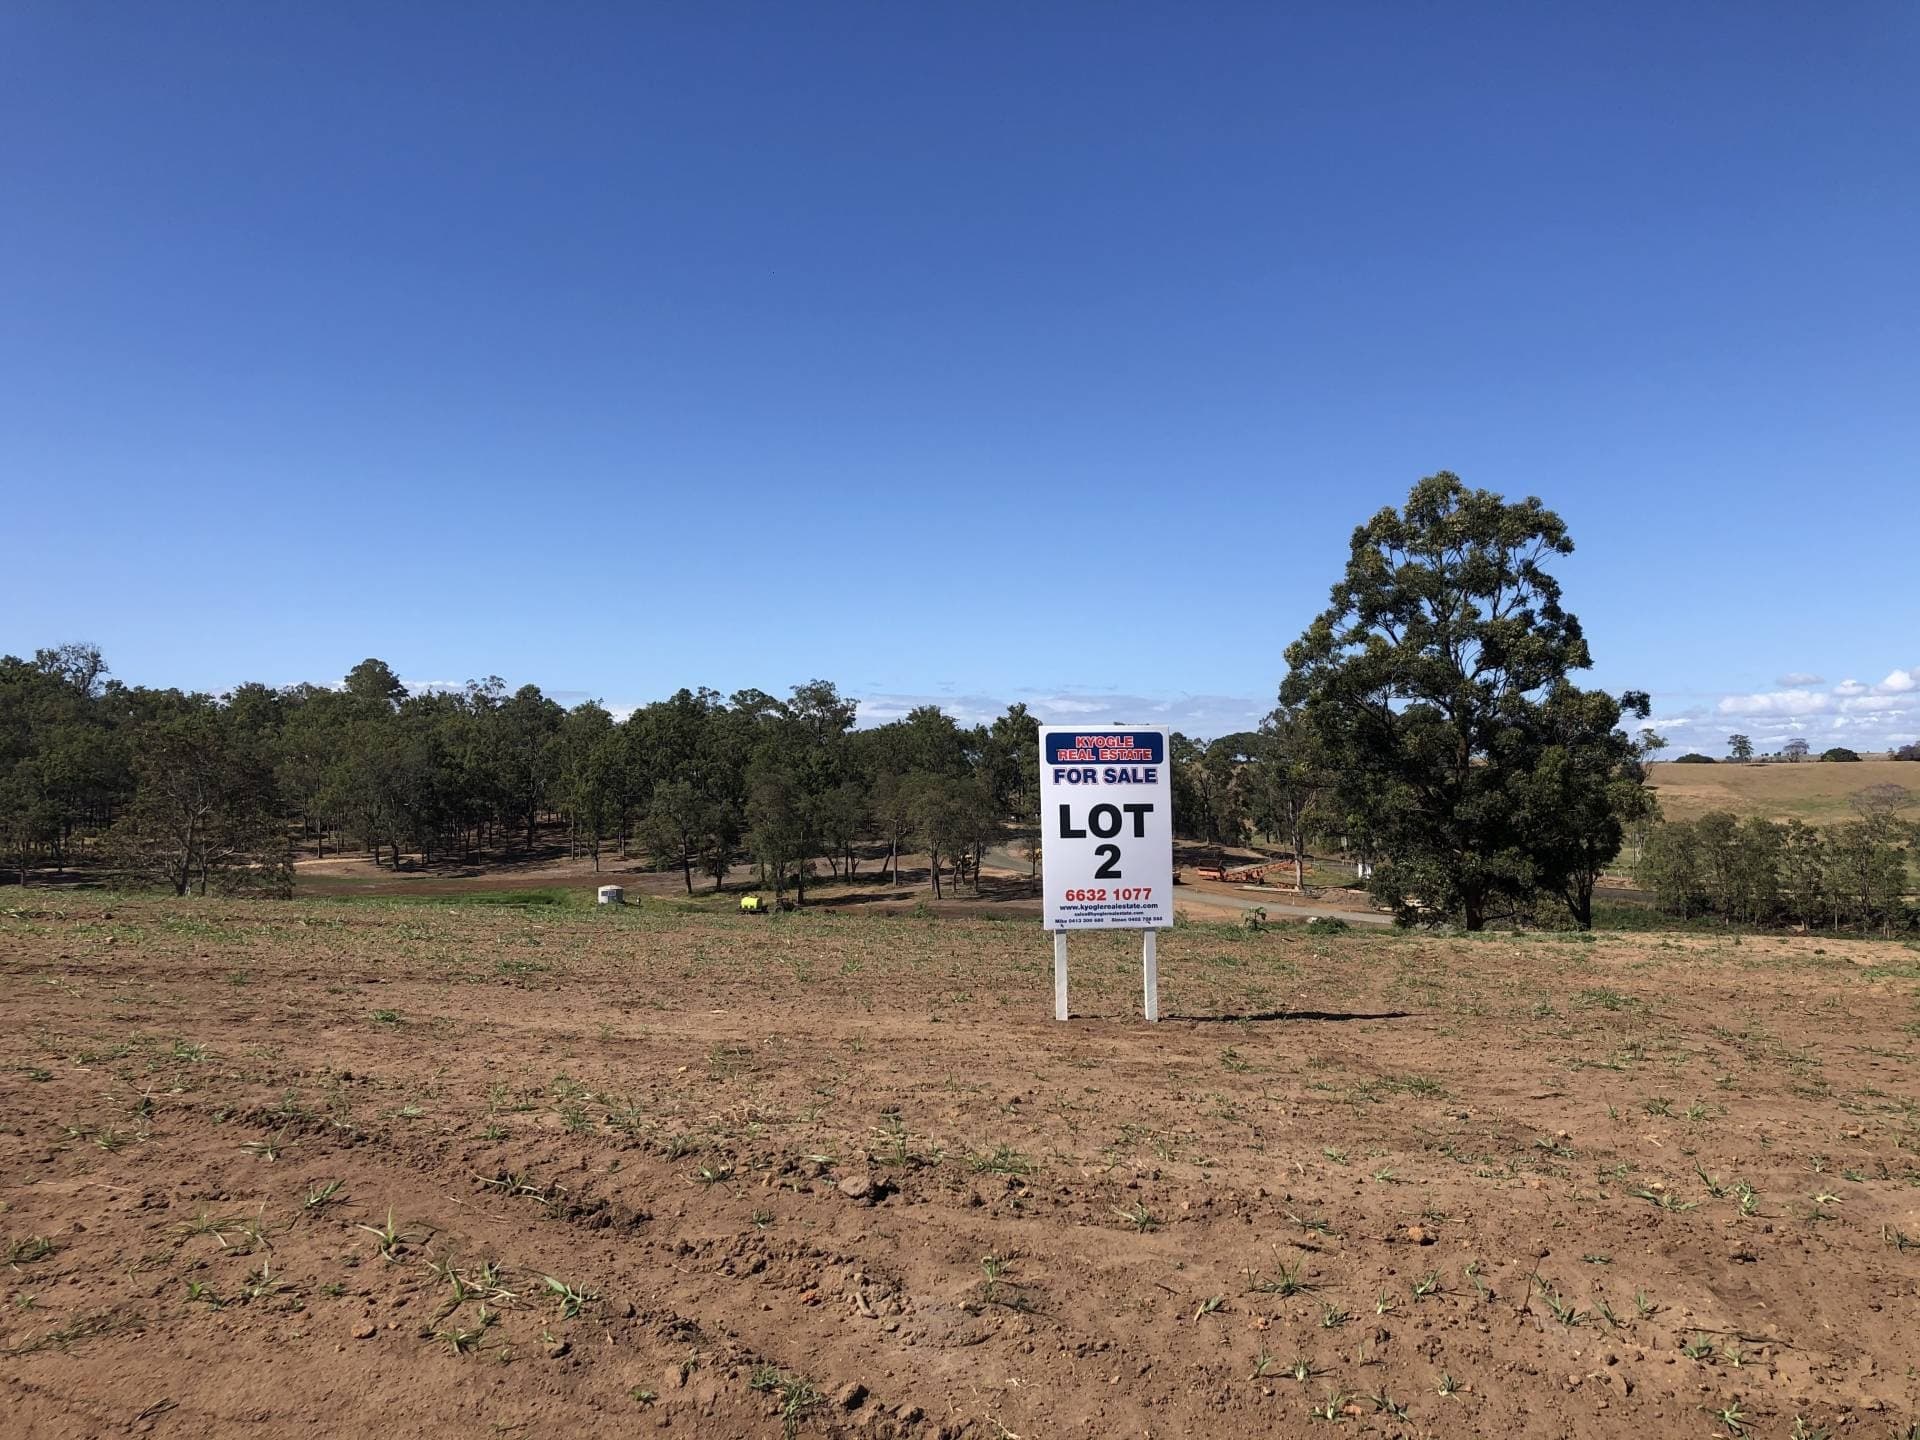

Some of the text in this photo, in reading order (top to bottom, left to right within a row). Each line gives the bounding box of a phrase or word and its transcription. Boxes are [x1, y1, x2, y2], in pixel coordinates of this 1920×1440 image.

[1075, 735, 1134, 748] KYOGLE
[1057, 749, 1152, 761] REAL ESTATE
[1053, 767, 1158, 784] FOR SALE
[1059, 803, 1154, 838] LOT
[1094, 843, 1122, 879] 2
[1065, 888, 1152, 902] 6632 1077
[1060, 902, 1158, 911] www.kyoglerealestate.com
